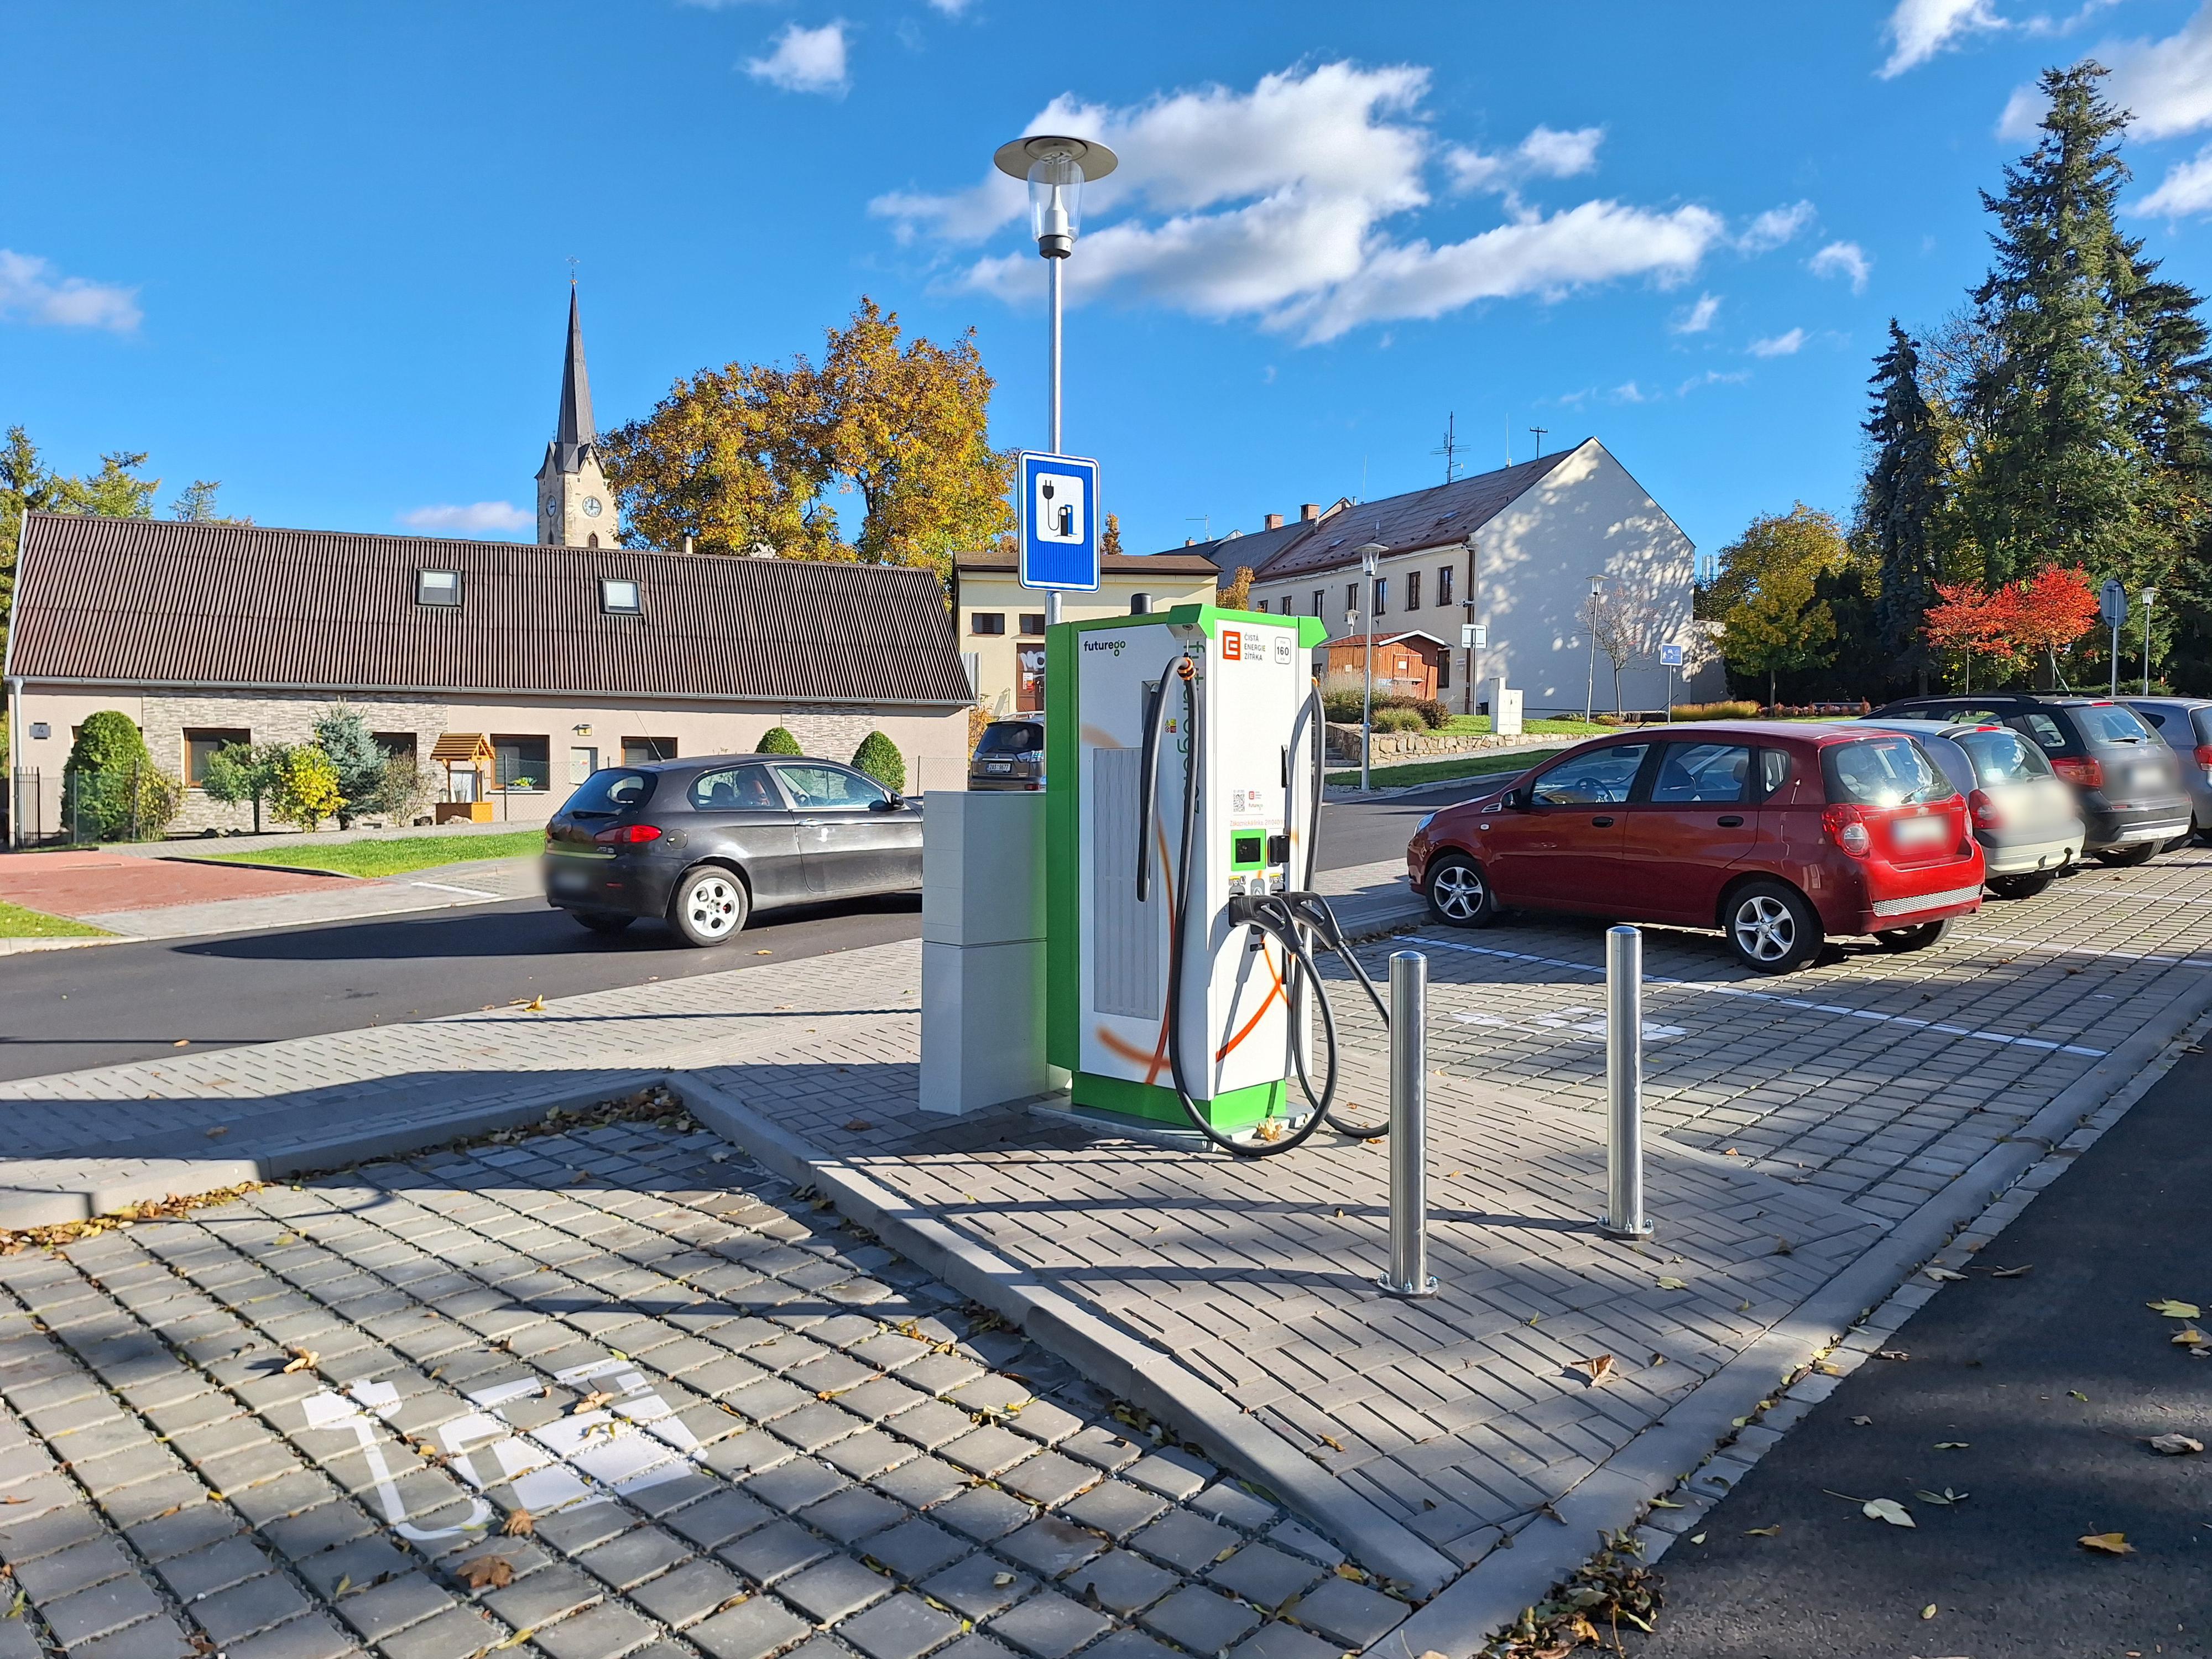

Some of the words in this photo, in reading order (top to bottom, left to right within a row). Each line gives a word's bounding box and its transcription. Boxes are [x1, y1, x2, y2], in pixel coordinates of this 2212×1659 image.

[1244, 633, 1259, 642] ČISTÁ
[1084, 640, 1126, 657] futurego
[1244, 643, 1265, 652] ENERGIE
[1277, 646, 1289, 655] 160
[1244, 652, 1262, 661] ZÍTŘKA
